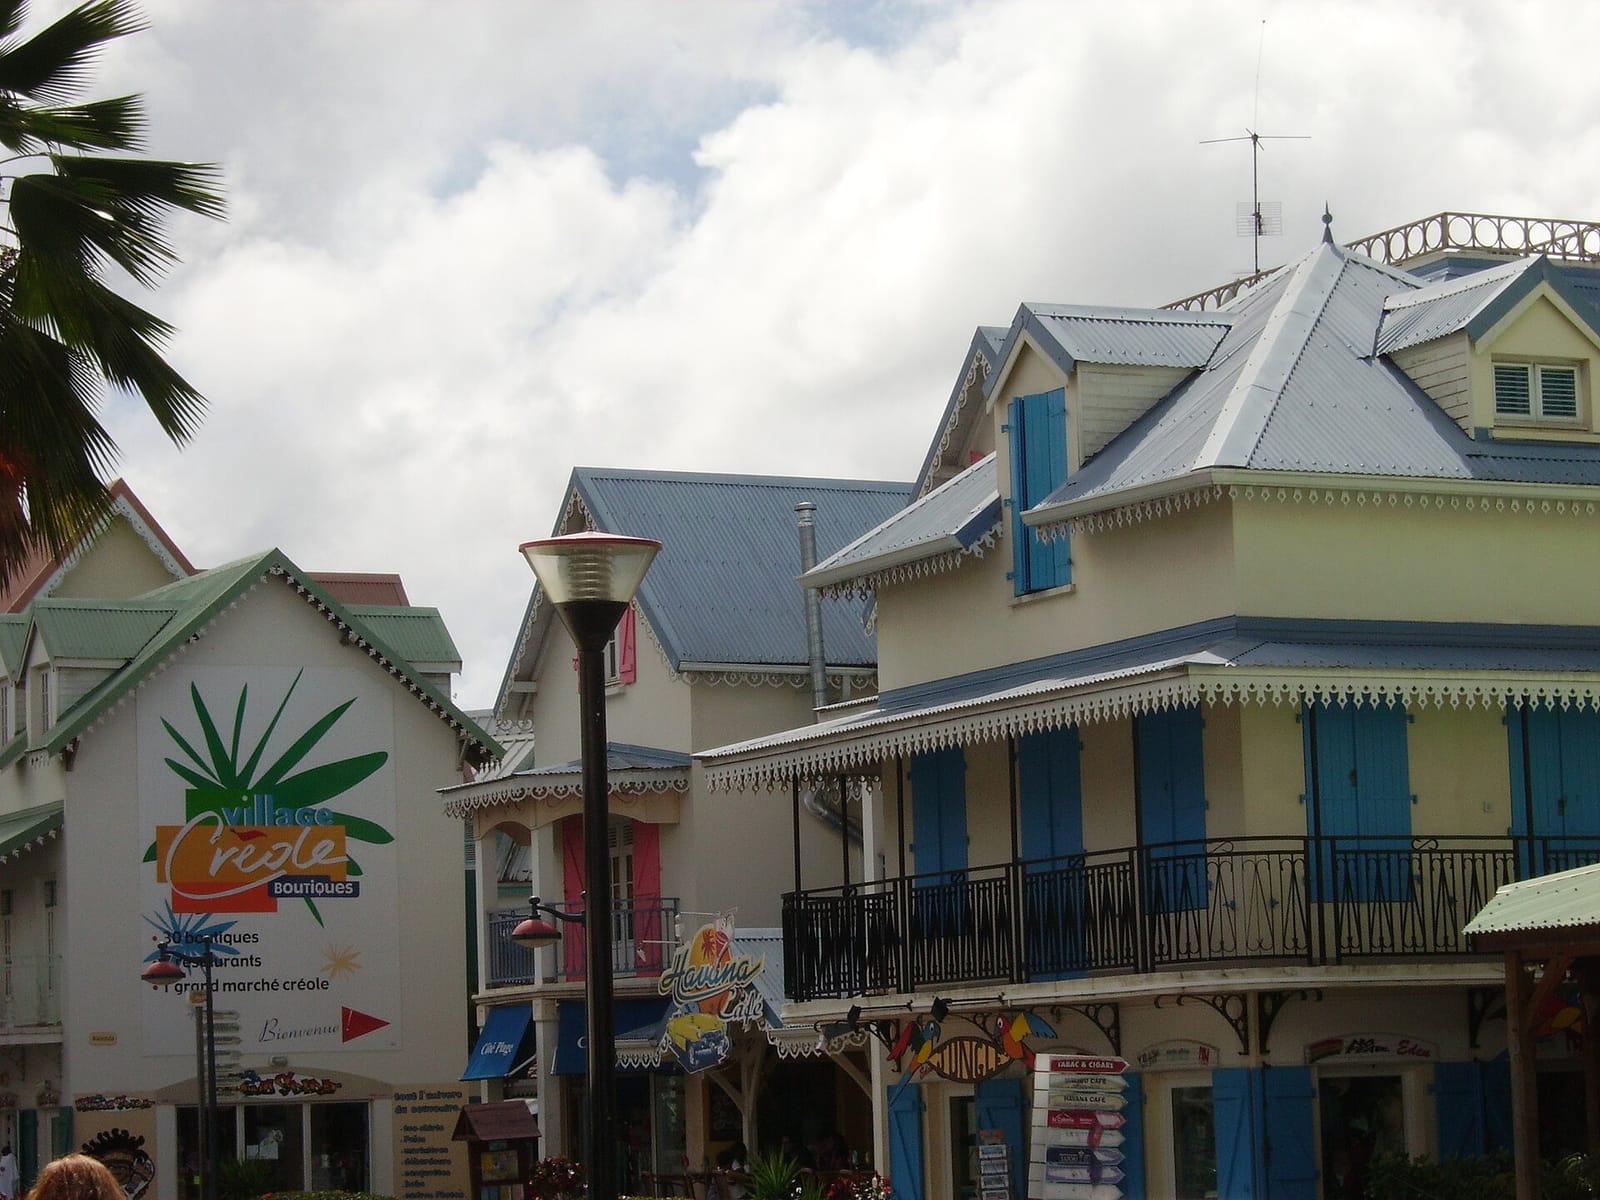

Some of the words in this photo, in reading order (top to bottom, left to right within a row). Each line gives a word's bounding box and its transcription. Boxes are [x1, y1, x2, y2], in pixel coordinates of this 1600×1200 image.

[185, 930, 260, 946] botiques
[222, 977, 280, 993] marché
[282, 976, 330, 991] créole
[258, 1017, 339, 1043] Bienvenue
[1396, 1039, 1431, 1058] Eden
[1057, 1060, 1081, 1070] TABAC
